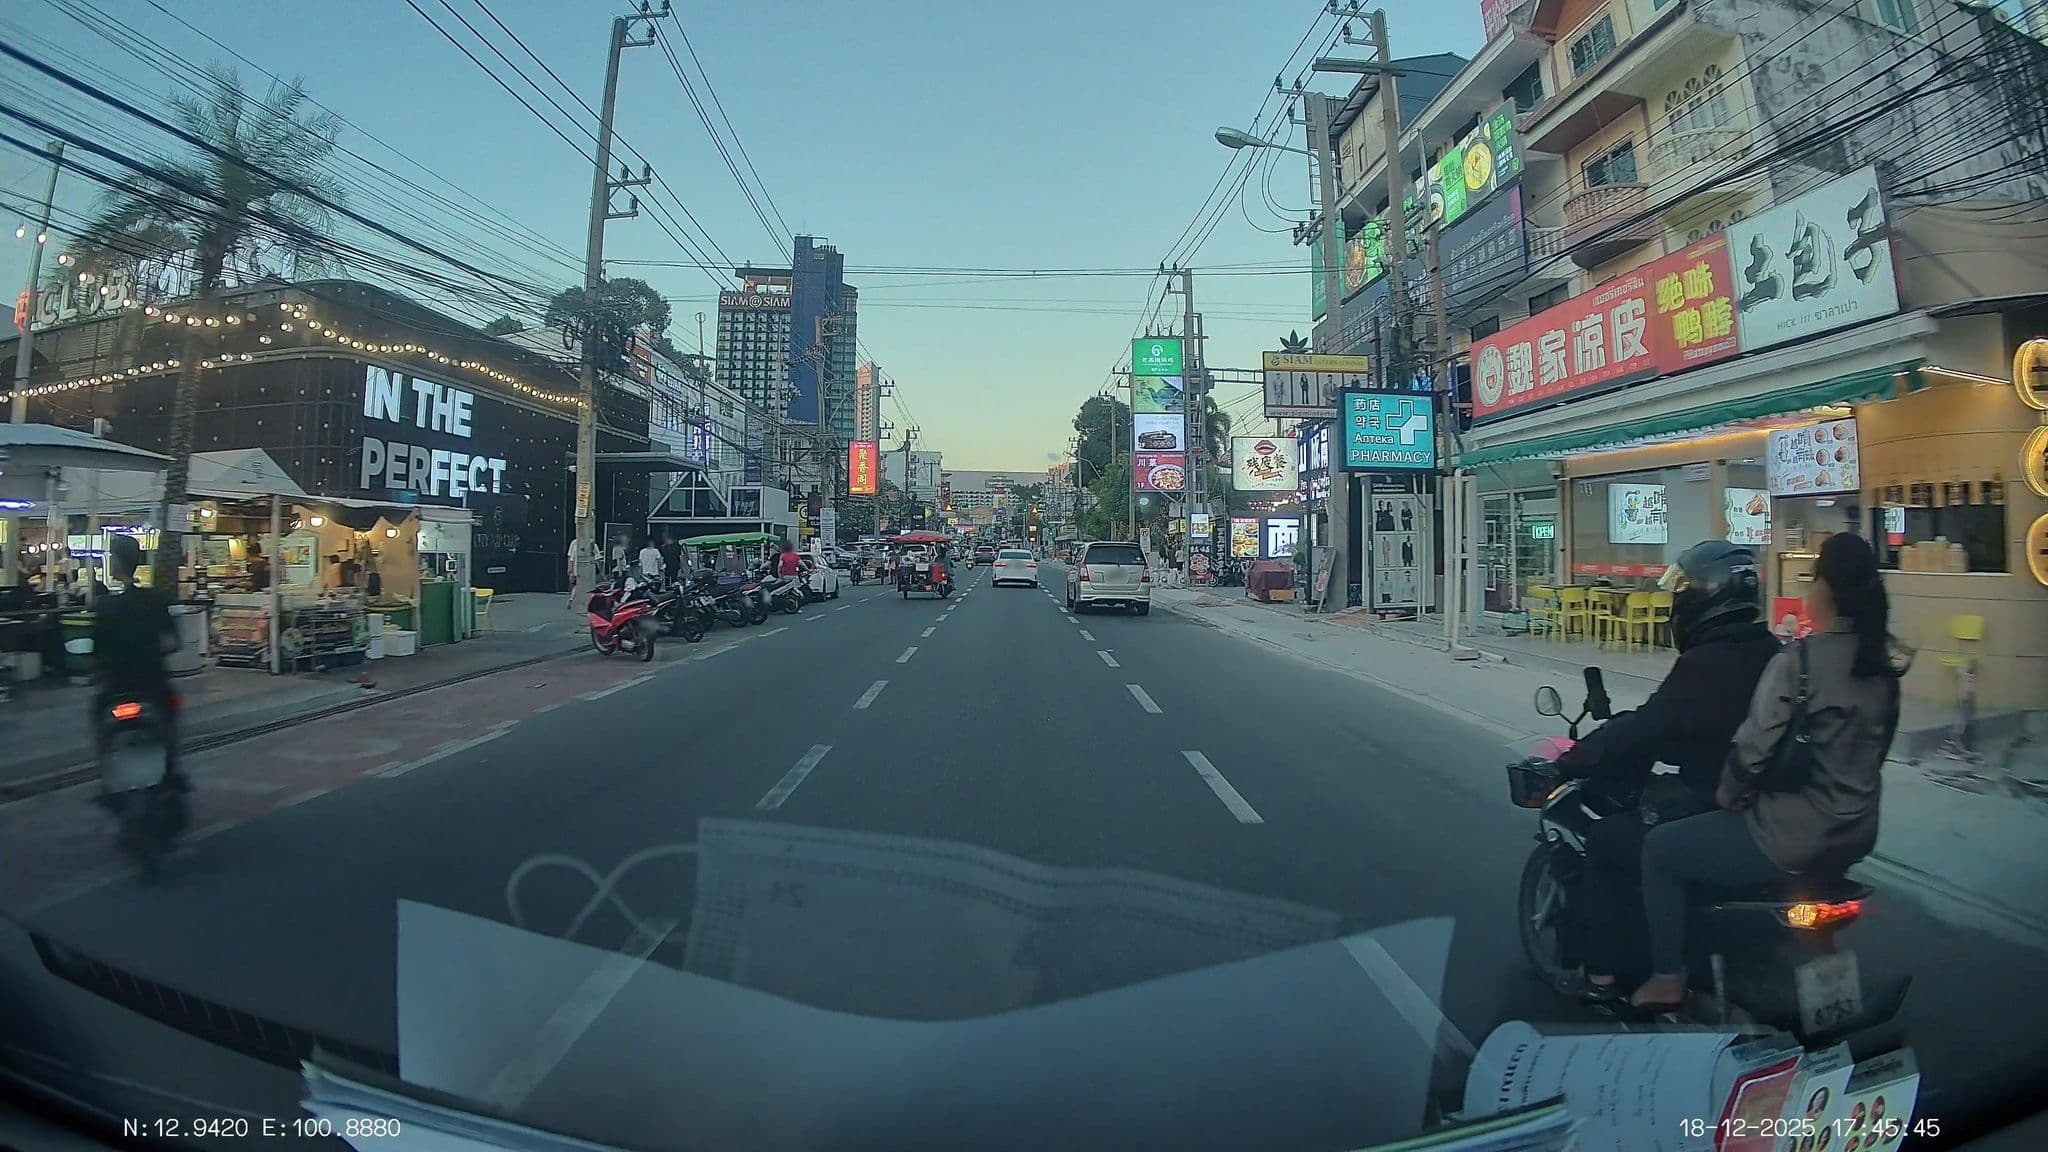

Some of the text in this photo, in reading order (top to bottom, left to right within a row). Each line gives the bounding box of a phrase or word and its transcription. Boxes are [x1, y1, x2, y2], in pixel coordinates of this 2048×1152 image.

[1739, 186, 1888, 314] 土包子
[1655, 260, 1715, 315] 绝味
[720, 294, 791, 308] SIAM@SIAM
[1776, 318, 1797, 331] HICK
[1506, 297, 1650, 397] 魏家凉皮
[1282, 355, 1313, 365] SIAM
[363, 364, 474, 439] IN THE
[1353, 398, 1381, 413] 药店
[1354, 415, 1381, 429] 약국
[1354, 432, 1395, 445] Аптека
[1351, 449, 1431, 464] PHARMACY
[360, 436, 507, 498] PERFECT
[1536, 526, 1552, 538] OPEN
